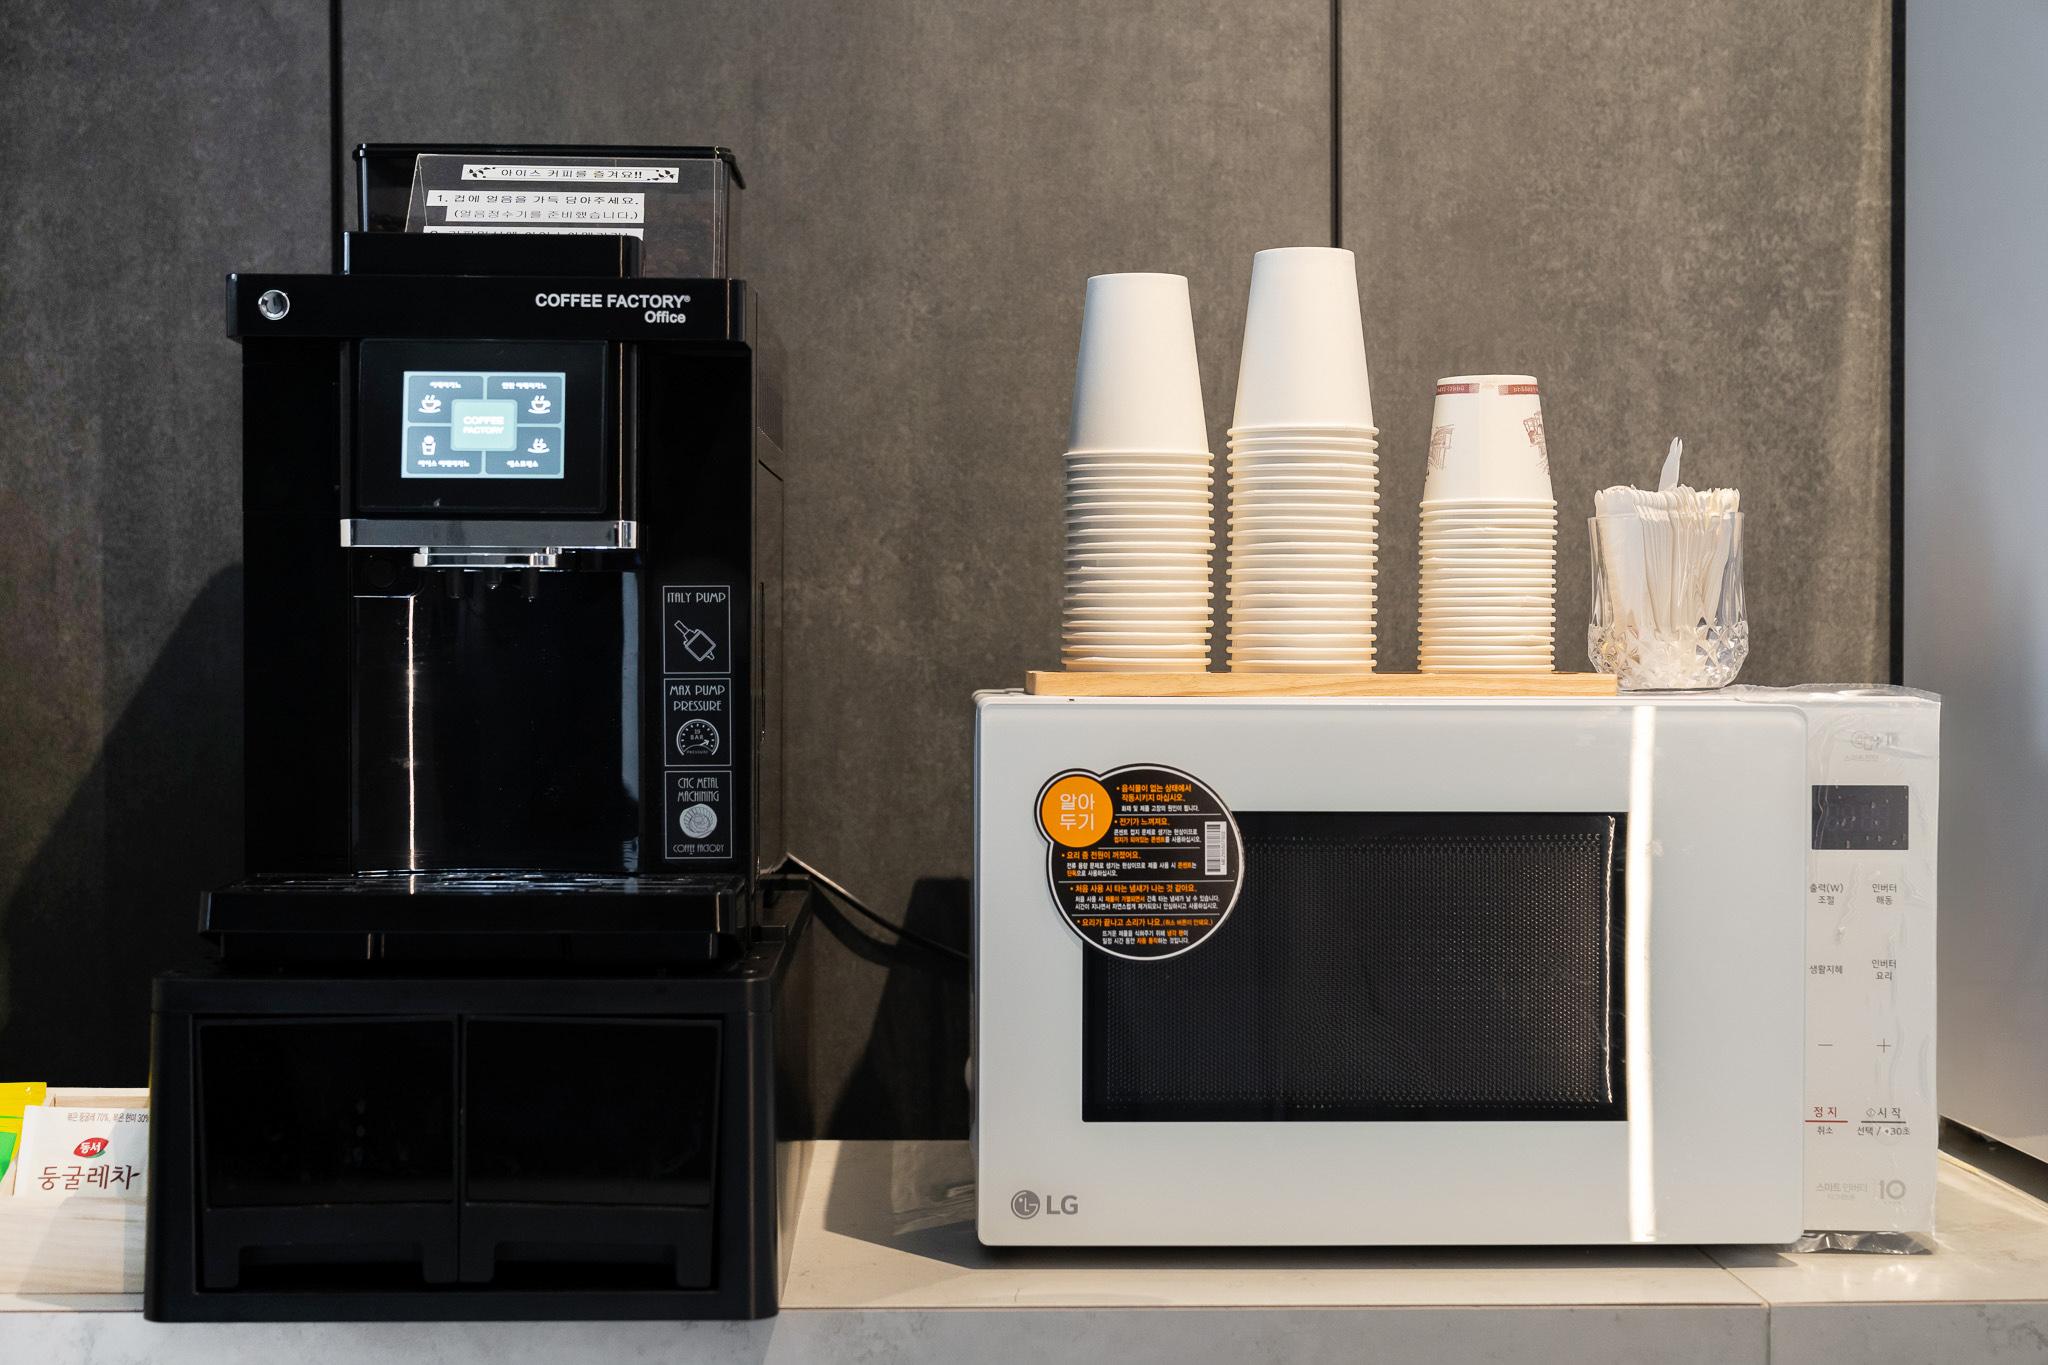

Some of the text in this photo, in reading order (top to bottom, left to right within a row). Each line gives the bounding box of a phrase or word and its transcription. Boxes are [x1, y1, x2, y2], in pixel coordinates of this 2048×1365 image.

[501, 169, 540, 177] 아이스
[454, 195, 480, 203] 컵에
[566, 196, 639, 205] 담아주세요.
[535, 293, 603, 308] COFFEE
[644, 310, 686, 324] Office
[463, 416, 505, 425] COFFEE
[667, 592, 726, 603] ITALY PUMP
[670, 685, 726, 696] MAX PUMP
[673, 700, 722, 712] PRESSURE
[678, 778, 719, 789] CNC METAL
[1122, 784, 1192, 792] 음식물이 없는 상태에서
[677, 791, 720, 802] MACHINING
[1060, 793, 1095, 811] 알아
[1122, 794, 1155, 802] 작동시키지
[1060, 813, 1095, 831] 두기
[1120, 818, 1139, 826] 전기가
[1810, 883, 1844, 894] 출력(W)
[1872, 884, 1897, 894] 인버터
[1818, 895, 1835, 906] 조절
[1876, 895, 1893, 905] 해동
[1810, 964, 1844, 975] 생활지혜
[1872, 959, 1897, 970] 인버터
[1876, 970, 1893, 981] 요리
[1817, 1126, 1833, 1135] 취소
[1857, 1126, 1874, 1136] 선택
[80, 1142, 102, 1154] 동서
[38, 1164, 141, 1190] 둥굴레차
[1880, 1180, 1906, 1200] 10
[1046, 1195, 1079, 1215] LG
